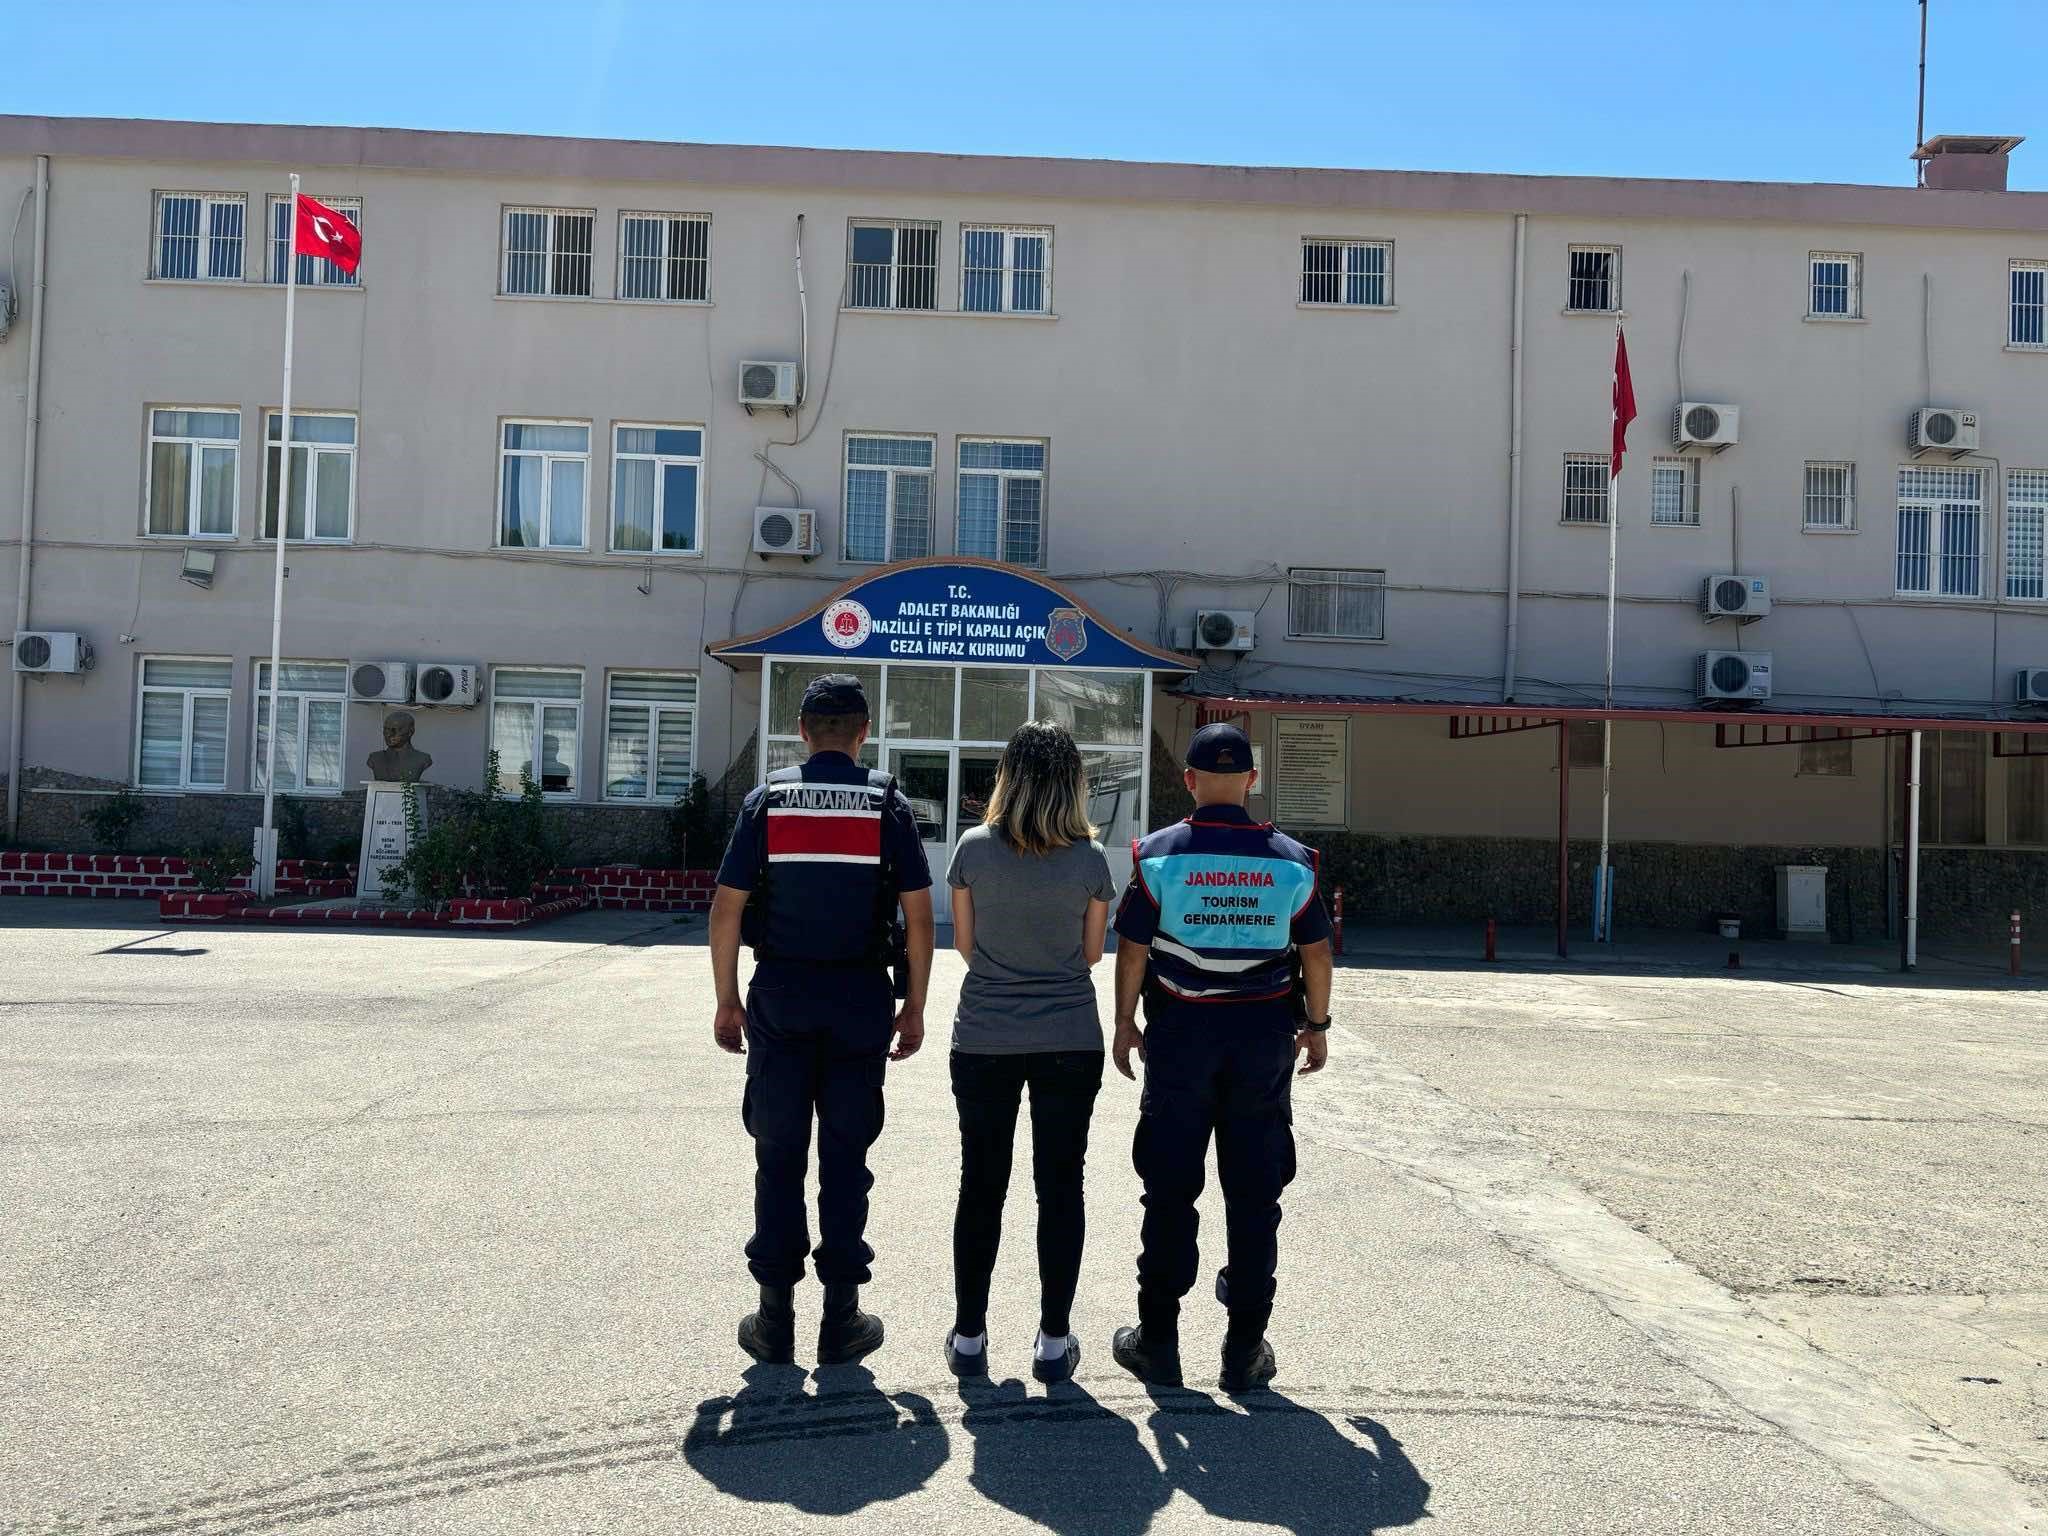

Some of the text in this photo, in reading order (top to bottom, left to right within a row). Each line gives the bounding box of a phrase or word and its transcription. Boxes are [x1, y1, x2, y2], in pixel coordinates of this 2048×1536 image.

[948, 585, 971, 599] T.C.
[898, 602, 1020, 620] ADALET BAKANLIĞI
[872, 618, 1046, 642] NAZİLLİ E TİPİ KAPALI AÇIK
[890, 638, 1026, 657] CEZA İNFAZ KURUMU
[780, 789, 871, 811] JANDARMA
[1184, 872, 1275, 887] JANDARMA
[1201, 897, 1259, 908] TOURISM
[1184, 914, 1276, 926] GENDARMERIE
